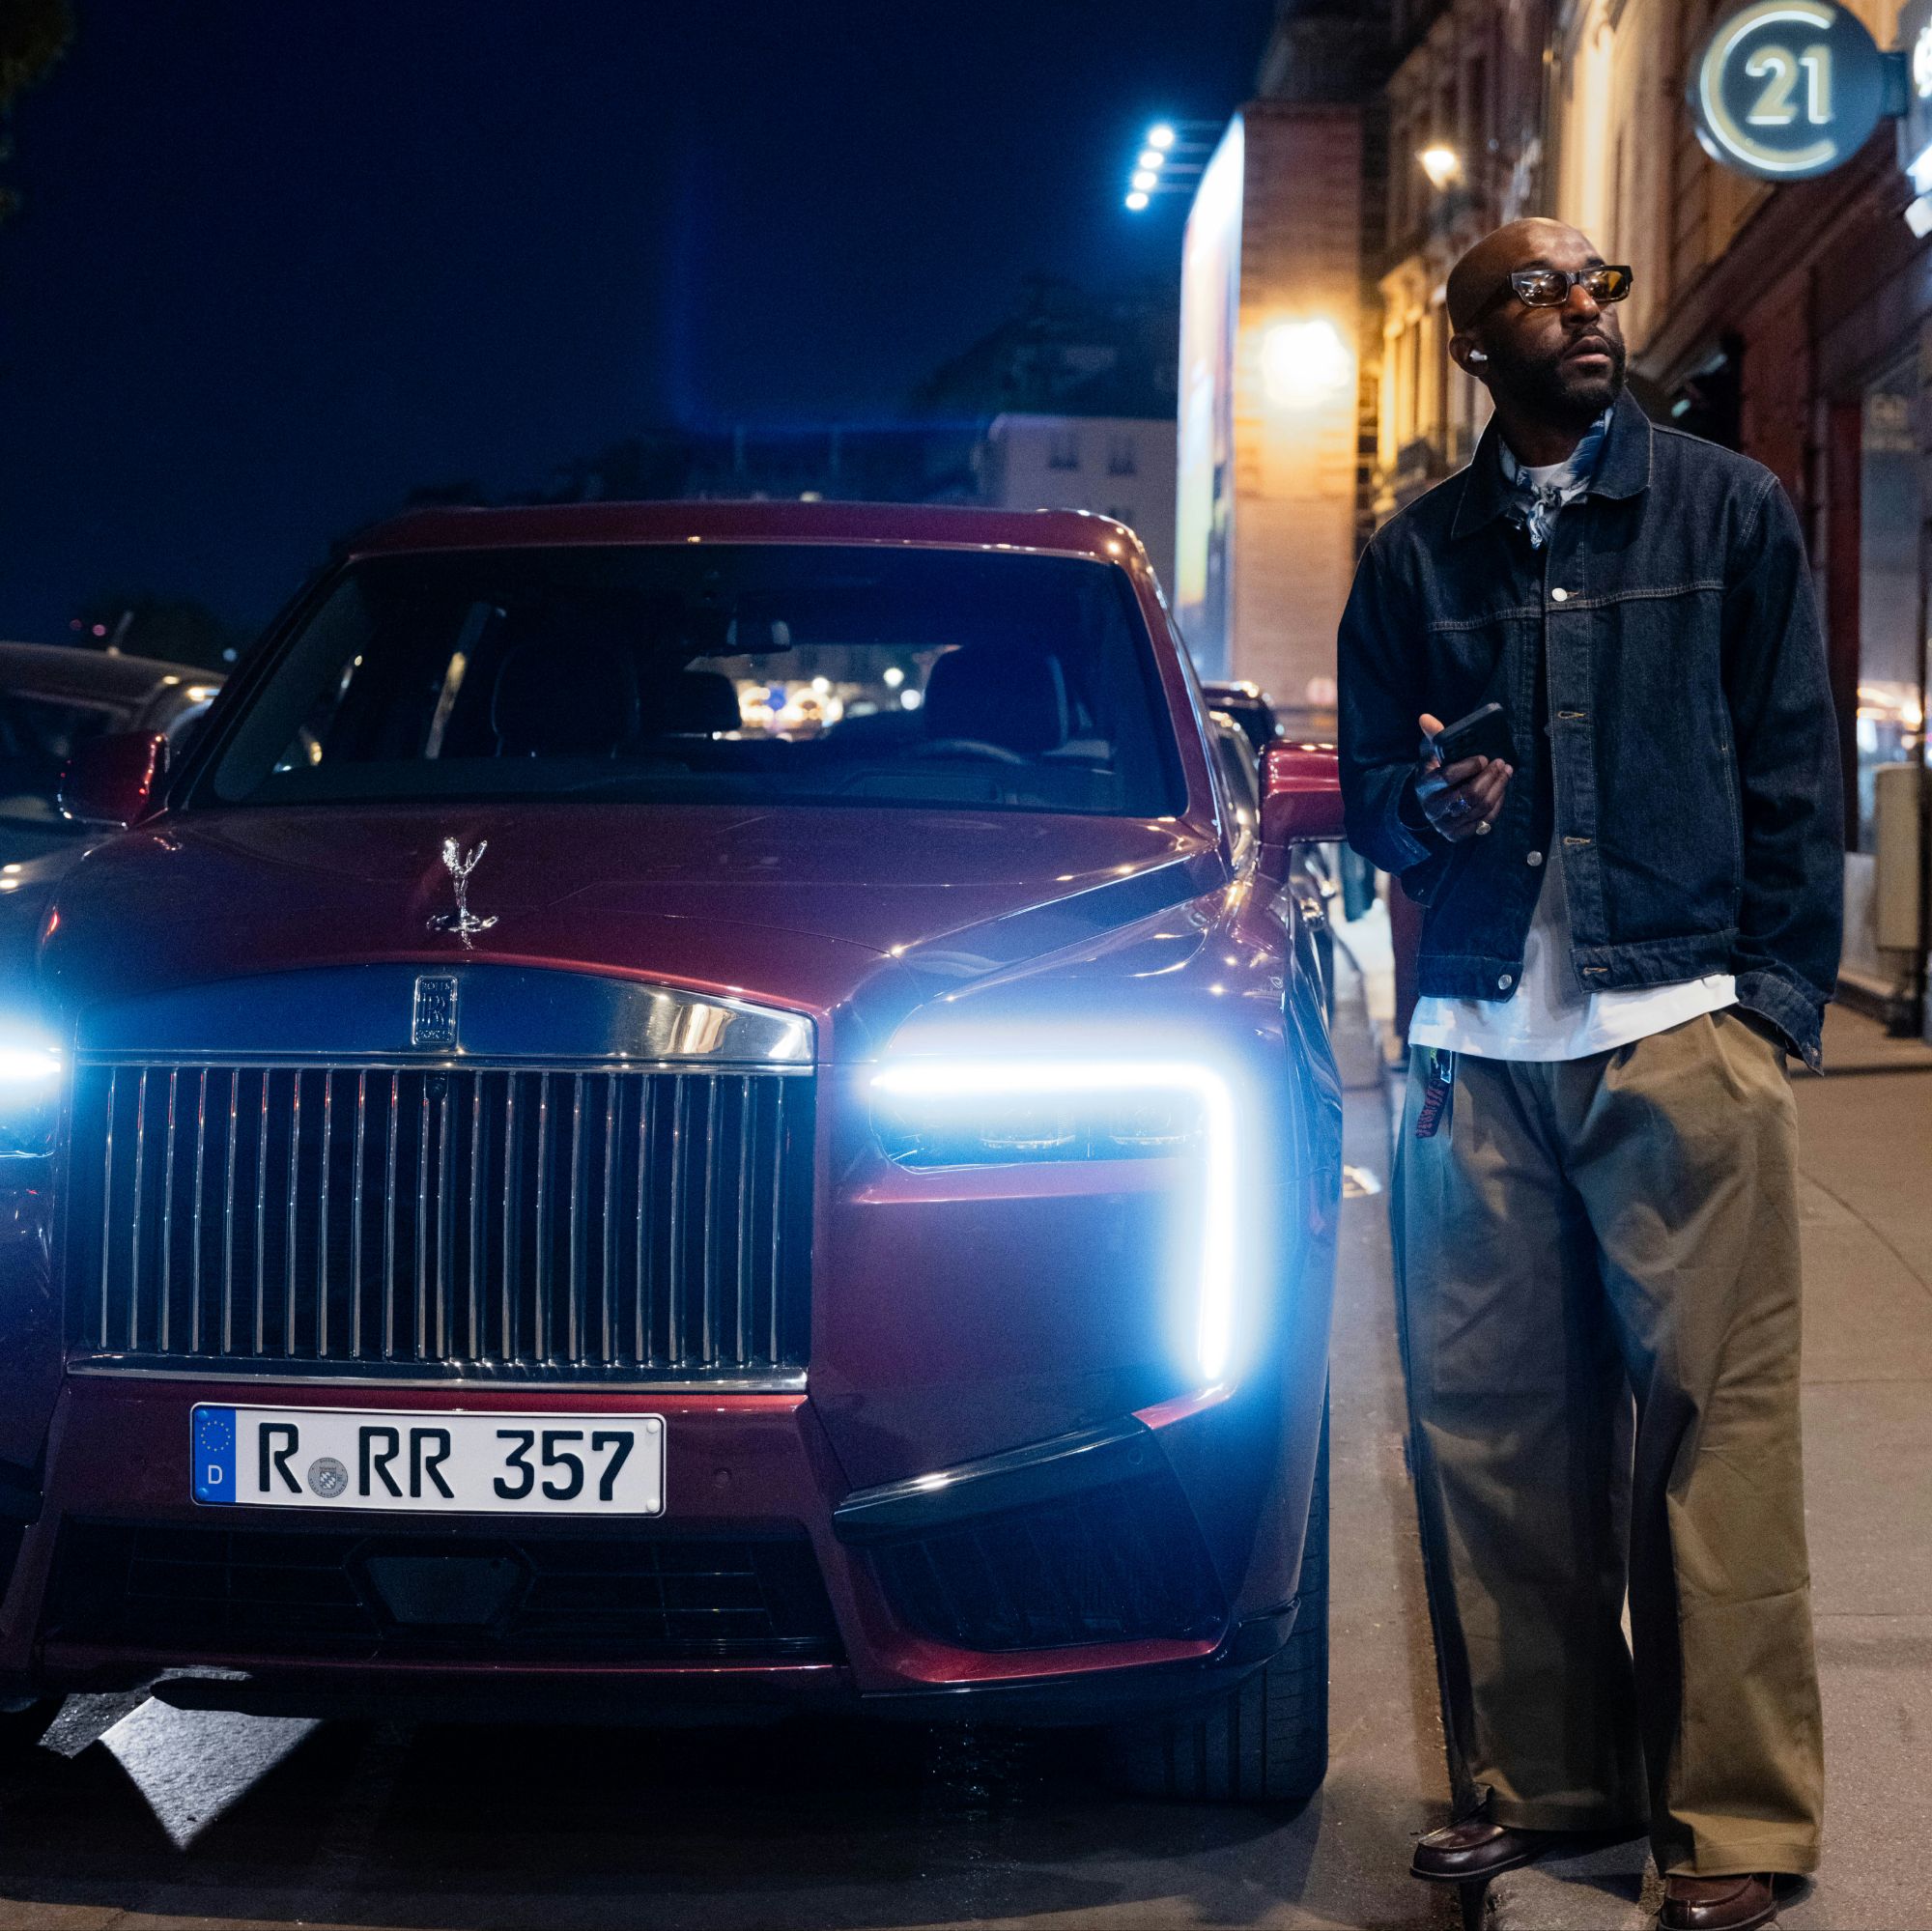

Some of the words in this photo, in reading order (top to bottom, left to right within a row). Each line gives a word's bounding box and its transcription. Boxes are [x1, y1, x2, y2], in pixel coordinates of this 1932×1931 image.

[1745, 45, 1833, 125] 21
[208, 1465, 223, 1484] D
[259, 1422, 302, 1493] R
[358, 1426, 455, 1498] RR
[493, 1430, 635, 1501] 357
